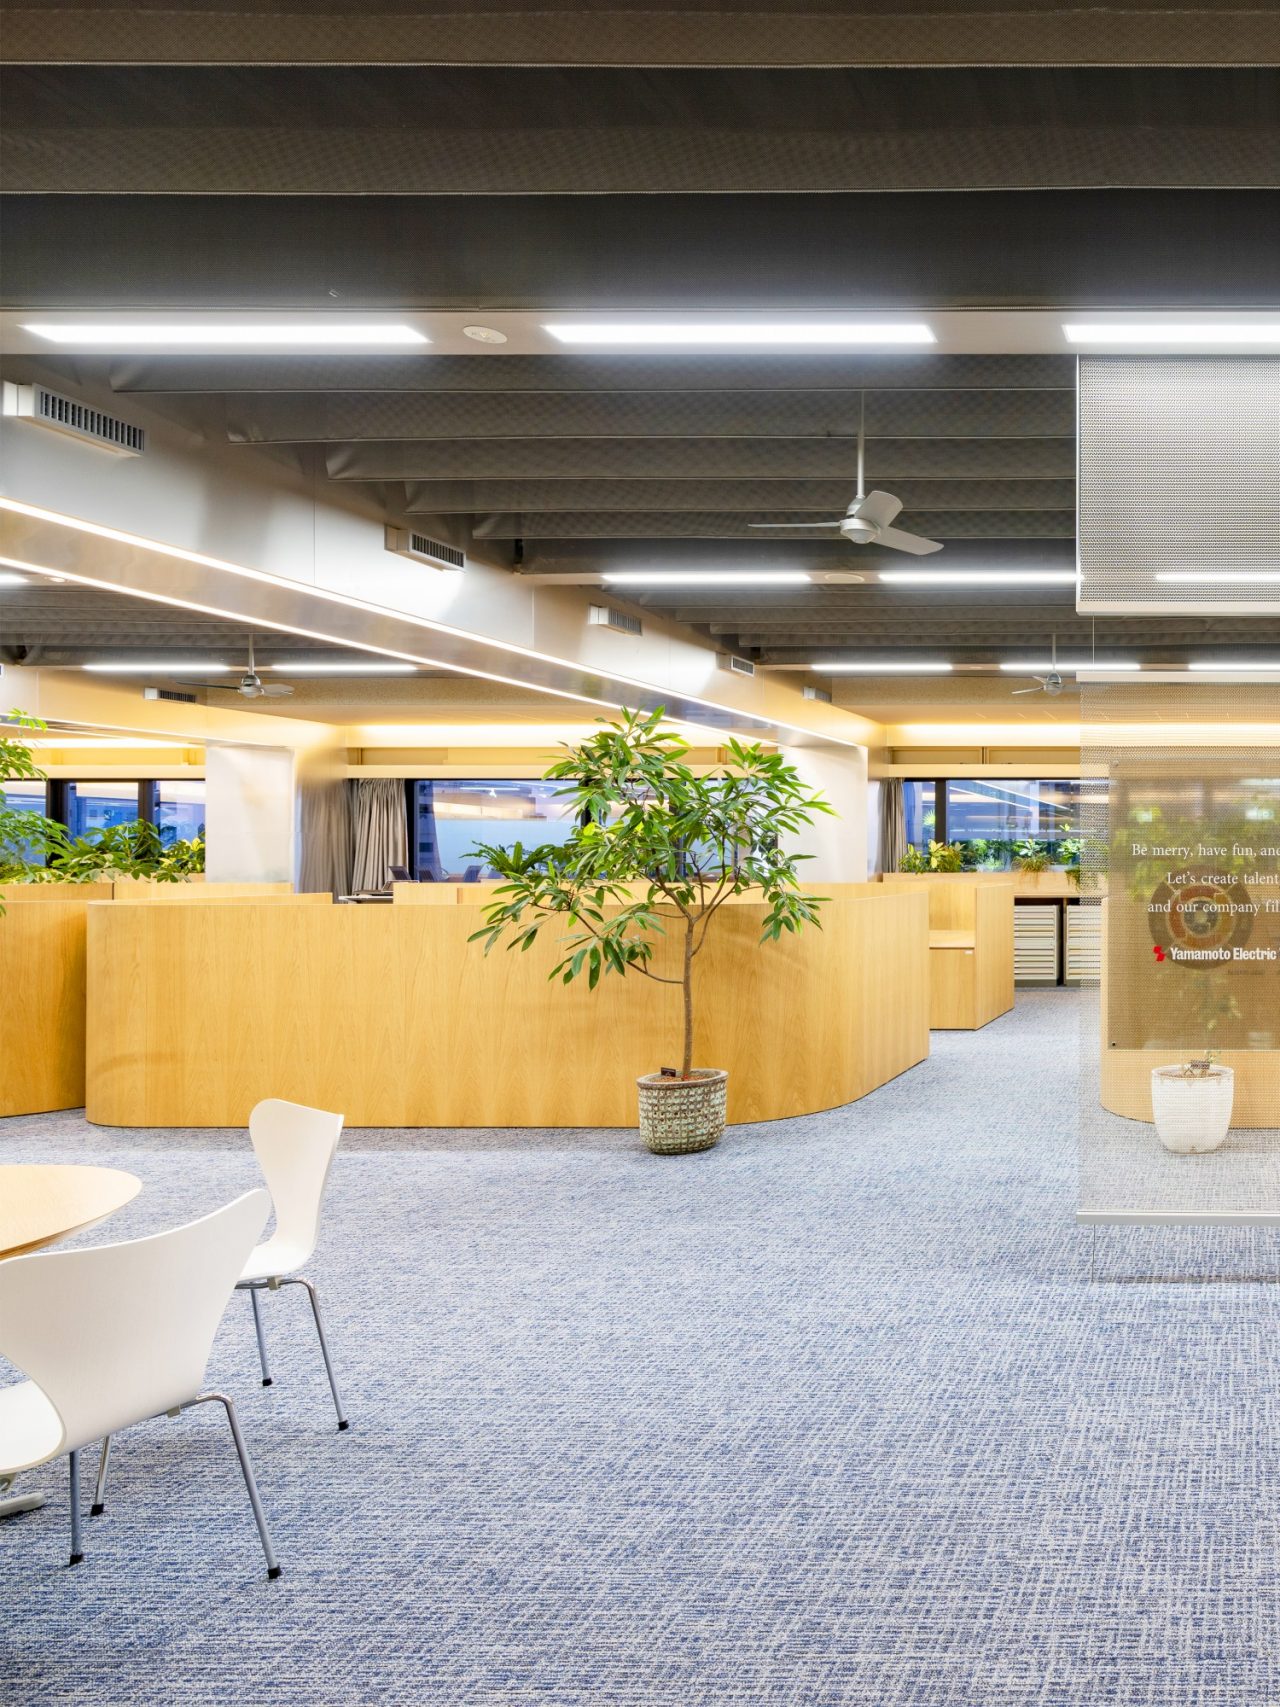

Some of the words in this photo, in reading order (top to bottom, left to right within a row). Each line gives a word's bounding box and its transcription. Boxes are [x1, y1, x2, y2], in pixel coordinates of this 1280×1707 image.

[1132, 844, 1148, 856] Be
[1152, 847, 1194, 860] merry,
[1198, 843, 1228, 856] have
[1232, 843, 1256, 858] fun,
[1201, 874, 1238, 884] create
[1148, 900, 1171, 912] and
[1176, 903, 1198, 912] our
[1203, 903, 1260, 916] company
[1170, 947, 1231, 960] Yamamoto
[1233, 947, 1277, 960] Electric
